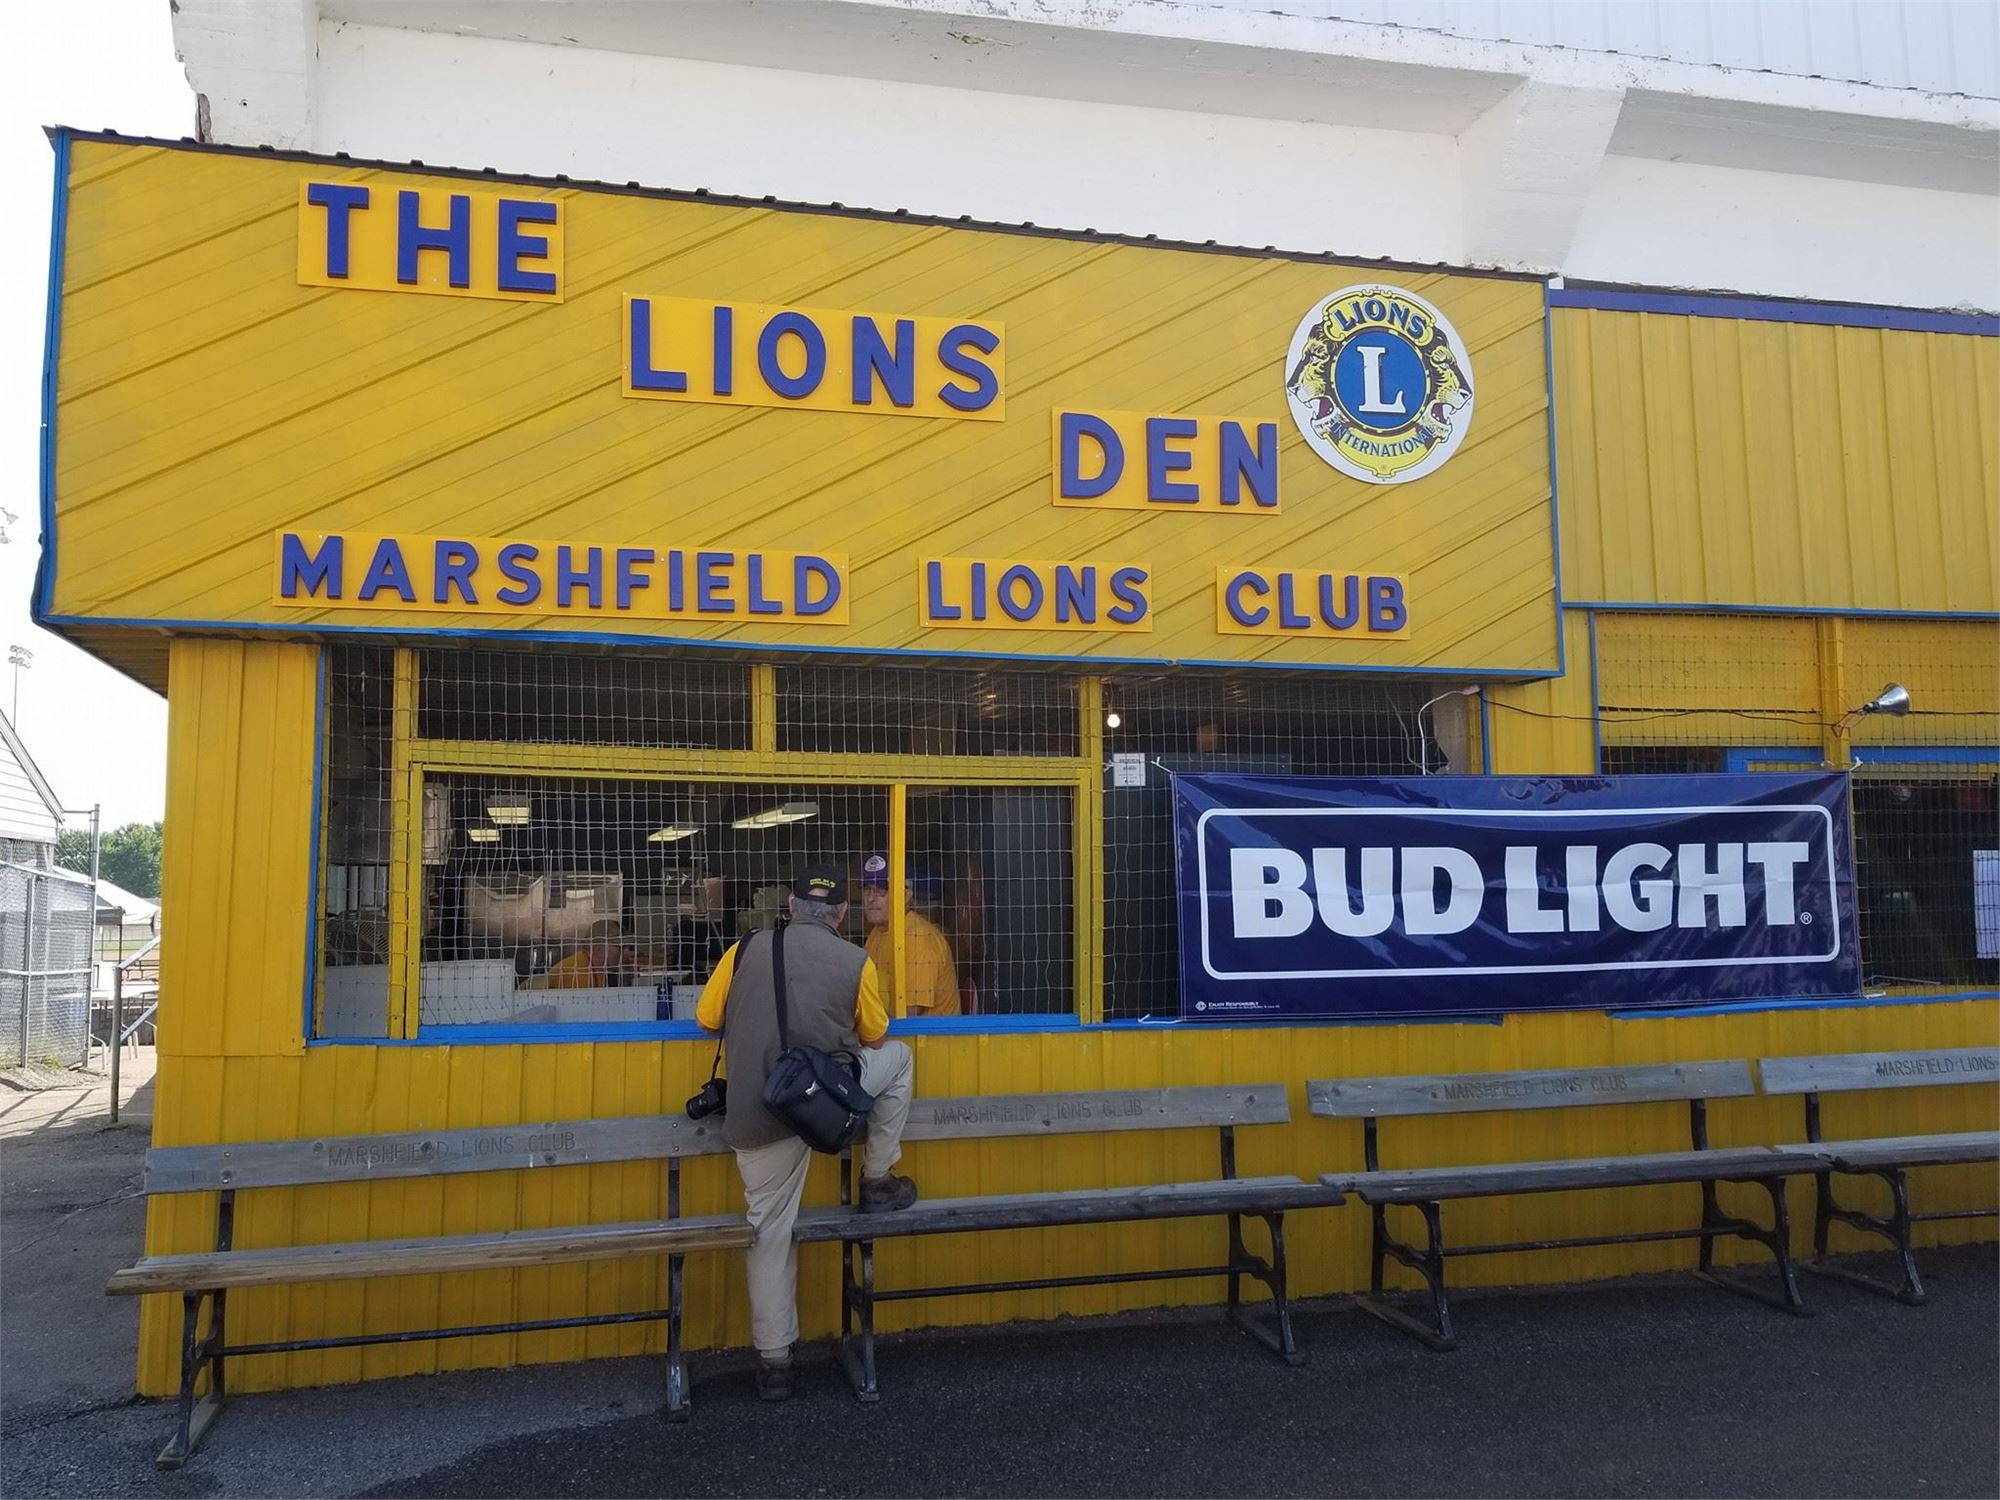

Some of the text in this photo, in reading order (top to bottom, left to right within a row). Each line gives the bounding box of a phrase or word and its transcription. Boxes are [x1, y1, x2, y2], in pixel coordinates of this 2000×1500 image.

[307, 182, 557, 292] THE
[1331, 299, 1428, 338] LIONS
[631, 298, 1000, 412] LIONS
[1357, 346, 1406, 413] L
[1062, 412, 1279, 508] DEN
[1329, 423, 1437, 458] INTERNATIONAL
[281, 534, 1410, 632] MARSHFIELD LIONS CLUB
[1230, 842, 1809, 938] BUD LIGHT
[1543, 1076, 1582, 1096] LIONS
[1591, 1074, 1628, 1092] CLUB
[1876, 1056, 1995, 1078] MARSHFIELD LIONS
[934, 1099, 1143, 1126] MARSHFIELD LIONS CLUB
[327, 1131, 576, 1168] MARSHFIED LIONS CLUB
